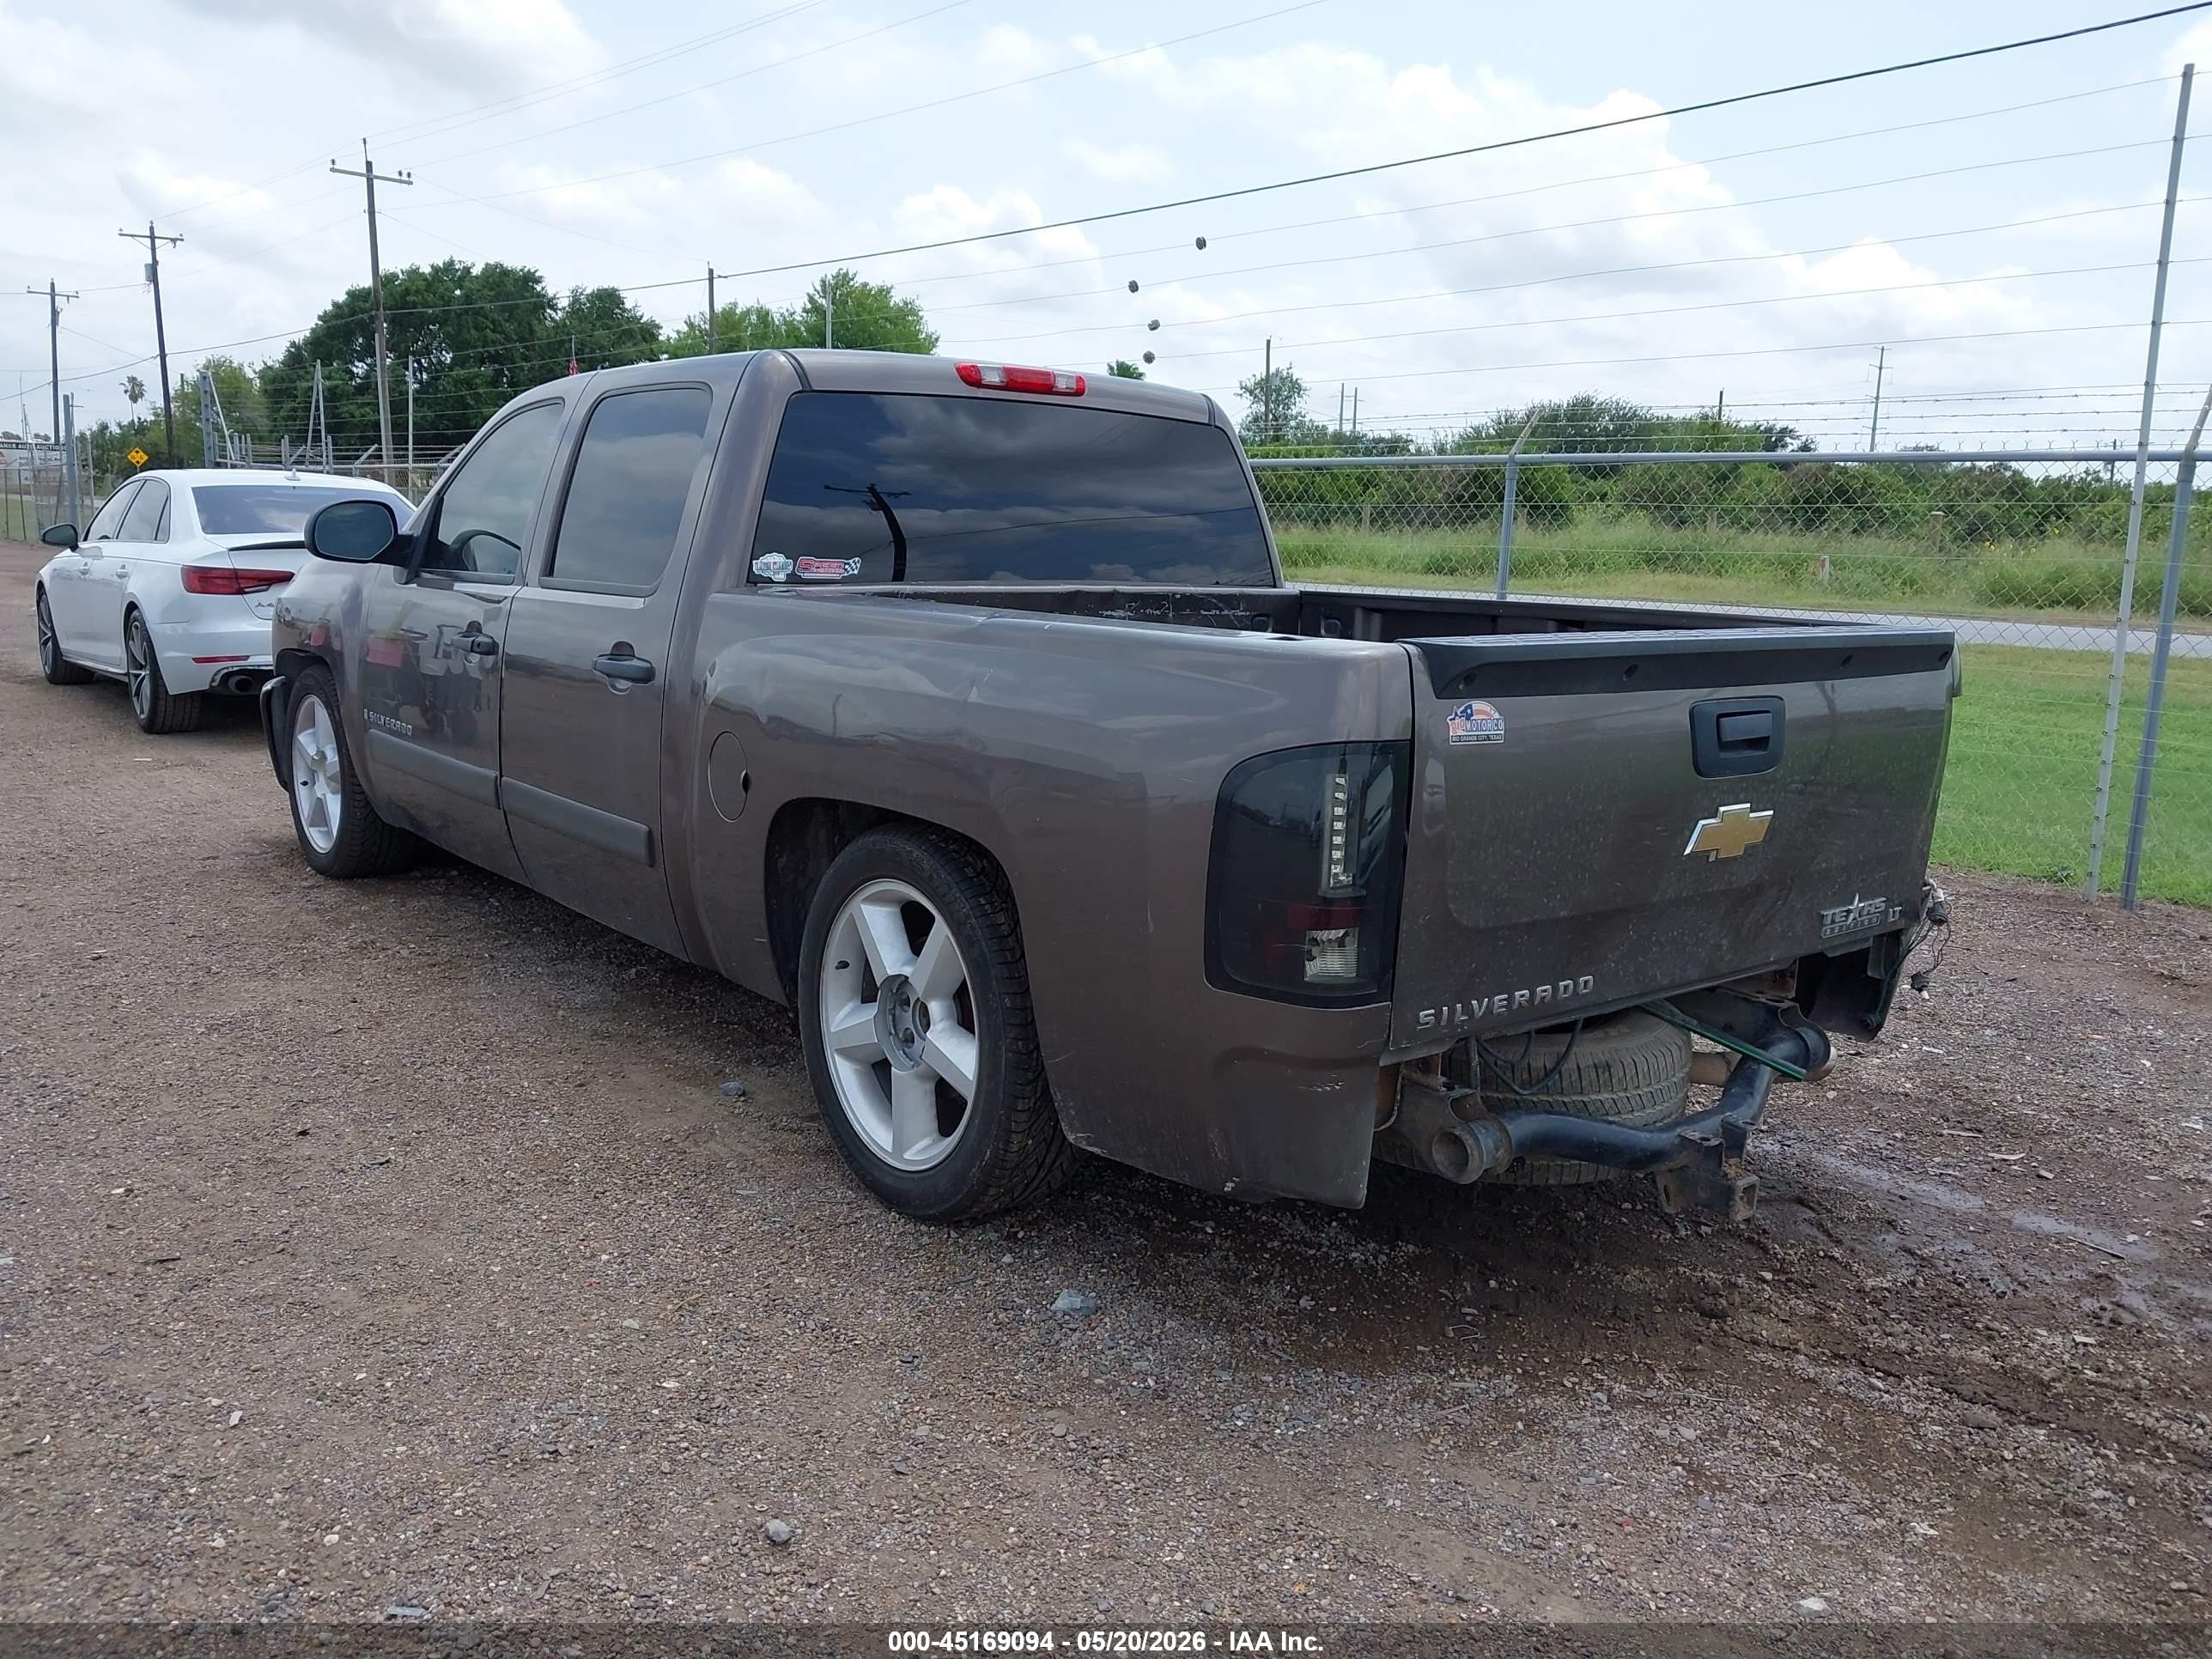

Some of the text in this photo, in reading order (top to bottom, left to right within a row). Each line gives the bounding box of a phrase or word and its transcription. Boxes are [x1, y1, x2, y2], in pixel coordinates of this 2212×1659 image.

[369, 711, 412, 736] SILVERADO
[1821, 893, 1902, 925] TEXAS LT
[1417, 975, 1594, 1030] SILVERADO
